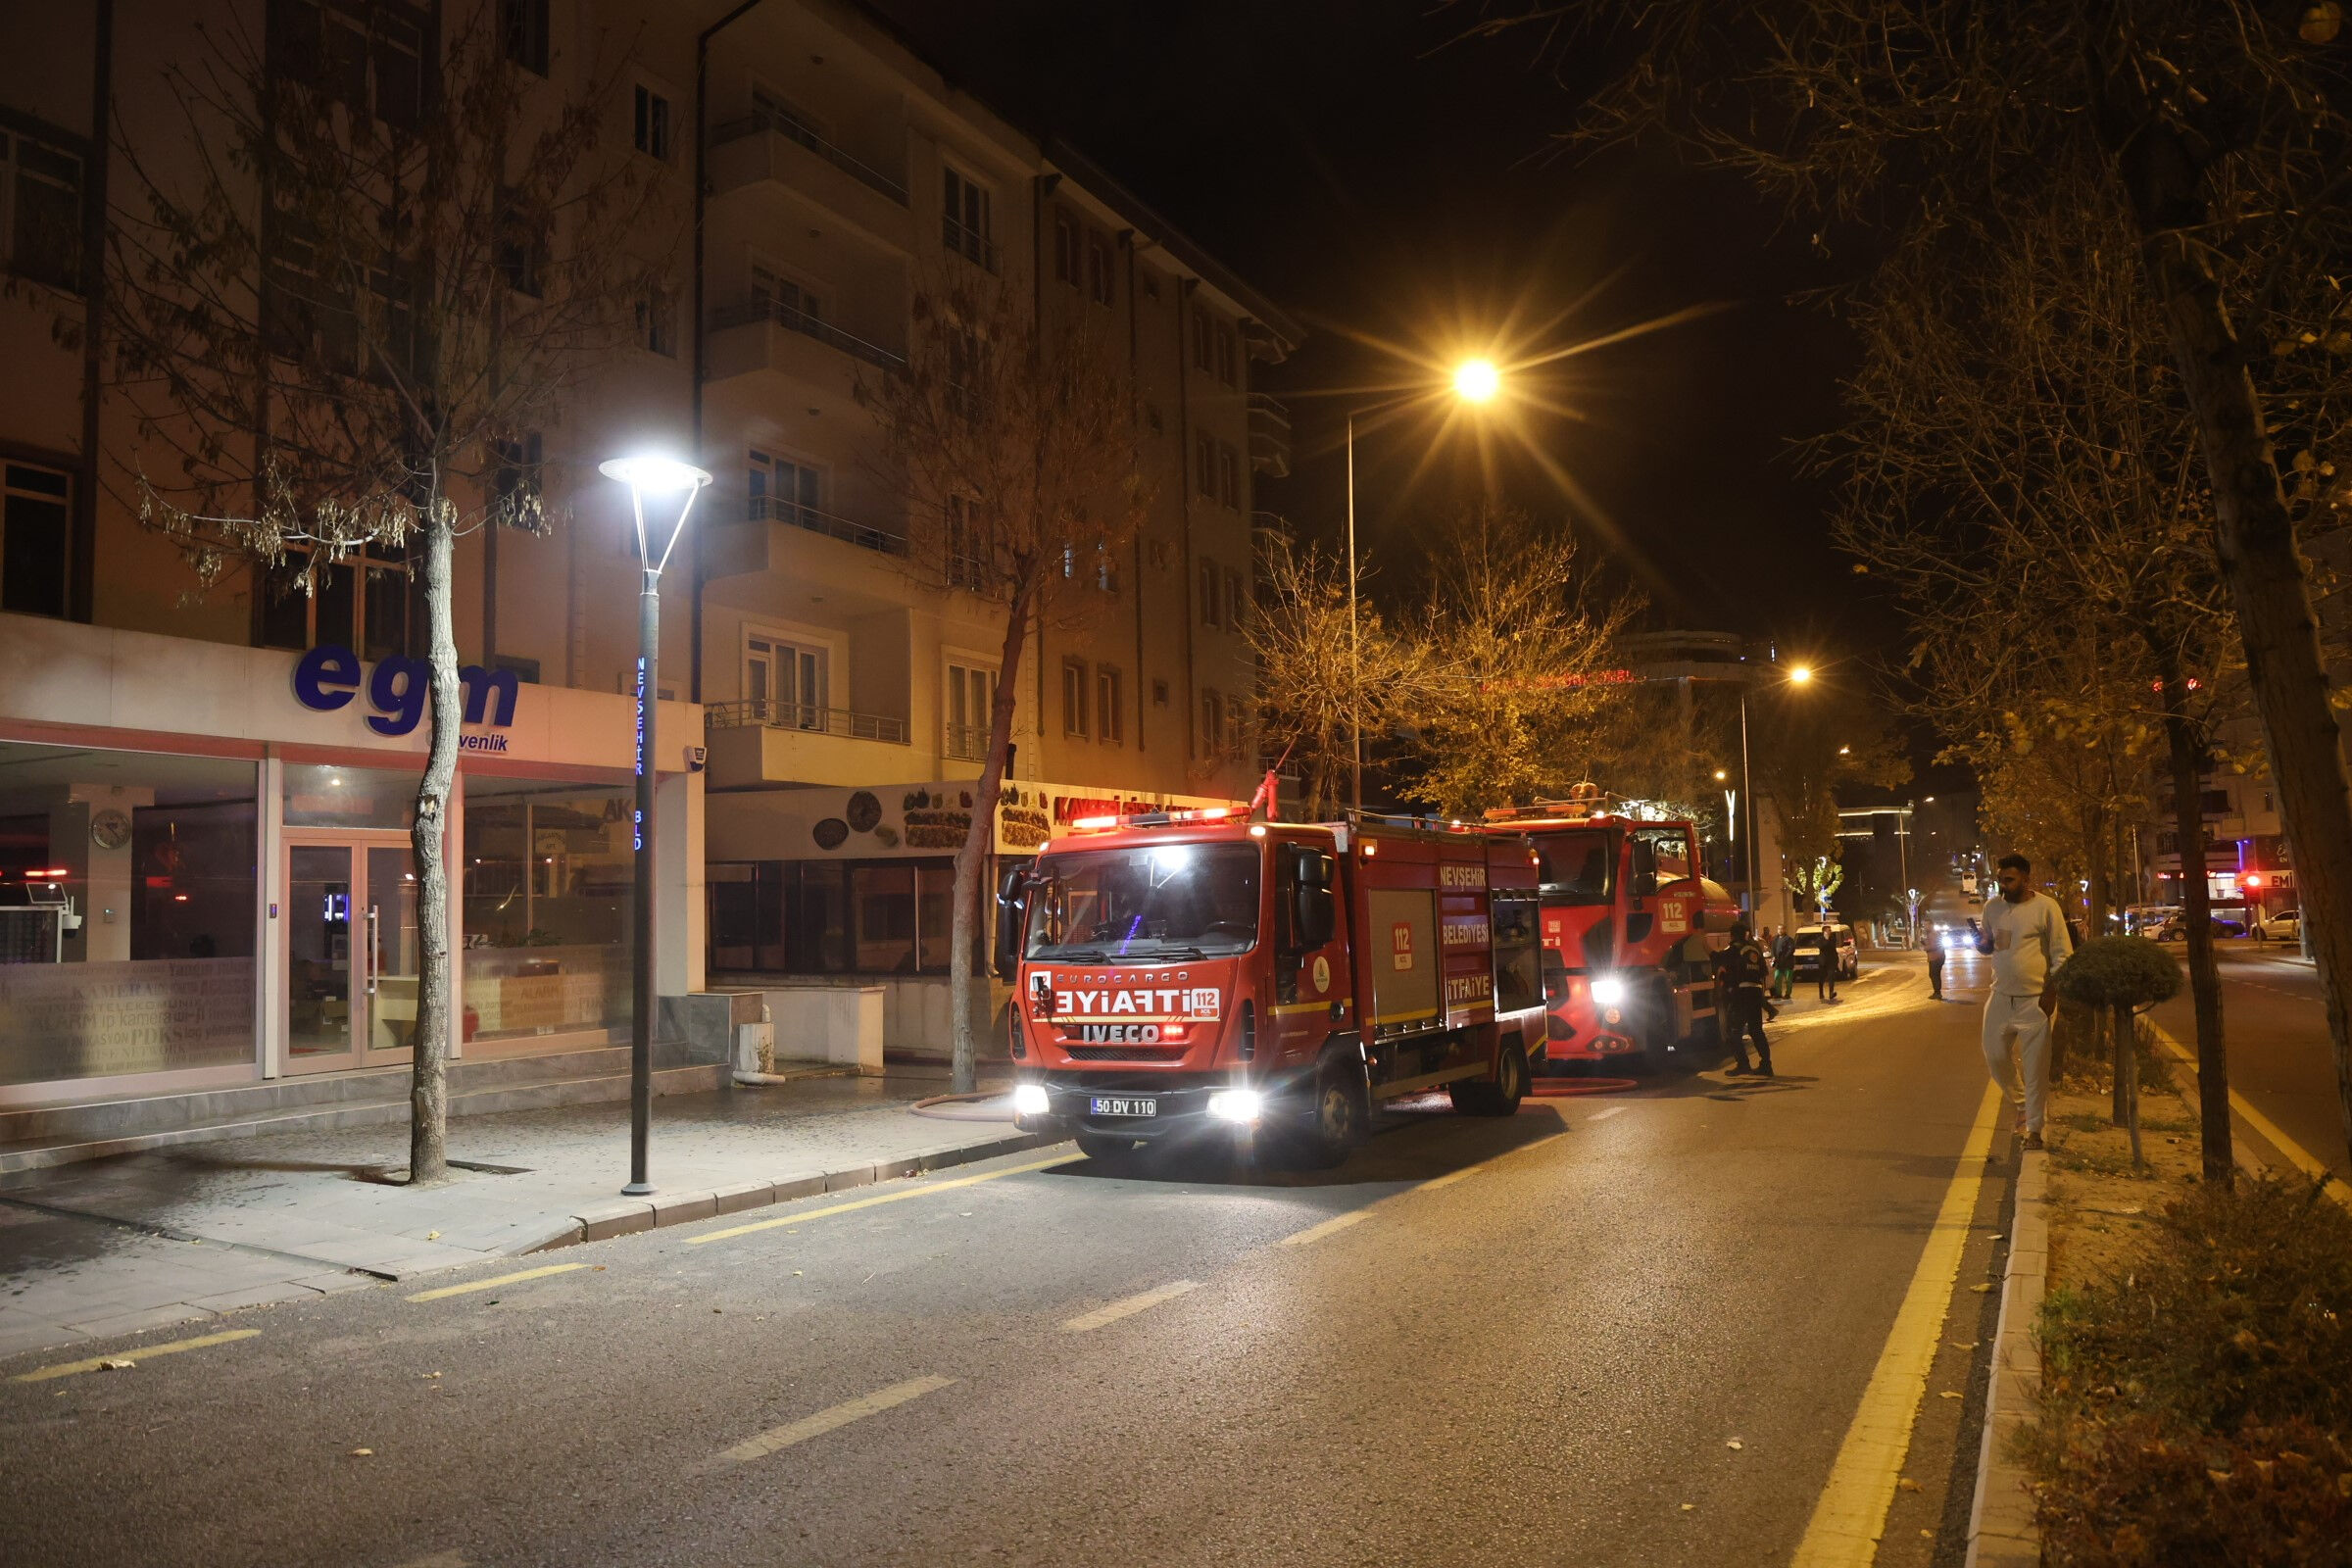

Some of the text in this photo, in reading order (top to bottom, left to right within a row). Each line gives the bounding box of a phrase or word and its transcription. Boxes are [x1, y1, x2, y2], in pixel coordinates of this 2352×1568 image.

[295, 644, 518, 736] egm
[458, 733, 509, 752] venlik
[633, 810, 643, 851] BLD
[1663, 903, 1683, 919] 112
[1395, 927, 1409, 951] 112
[1055, 971, 1189, 984] EUROCARGO
[1196, 992, 1215, 1005] 112
[1083, 1025, 1159, 1044] IVECO
[1097, 1100, 1154, 1114] 50 DV 110
